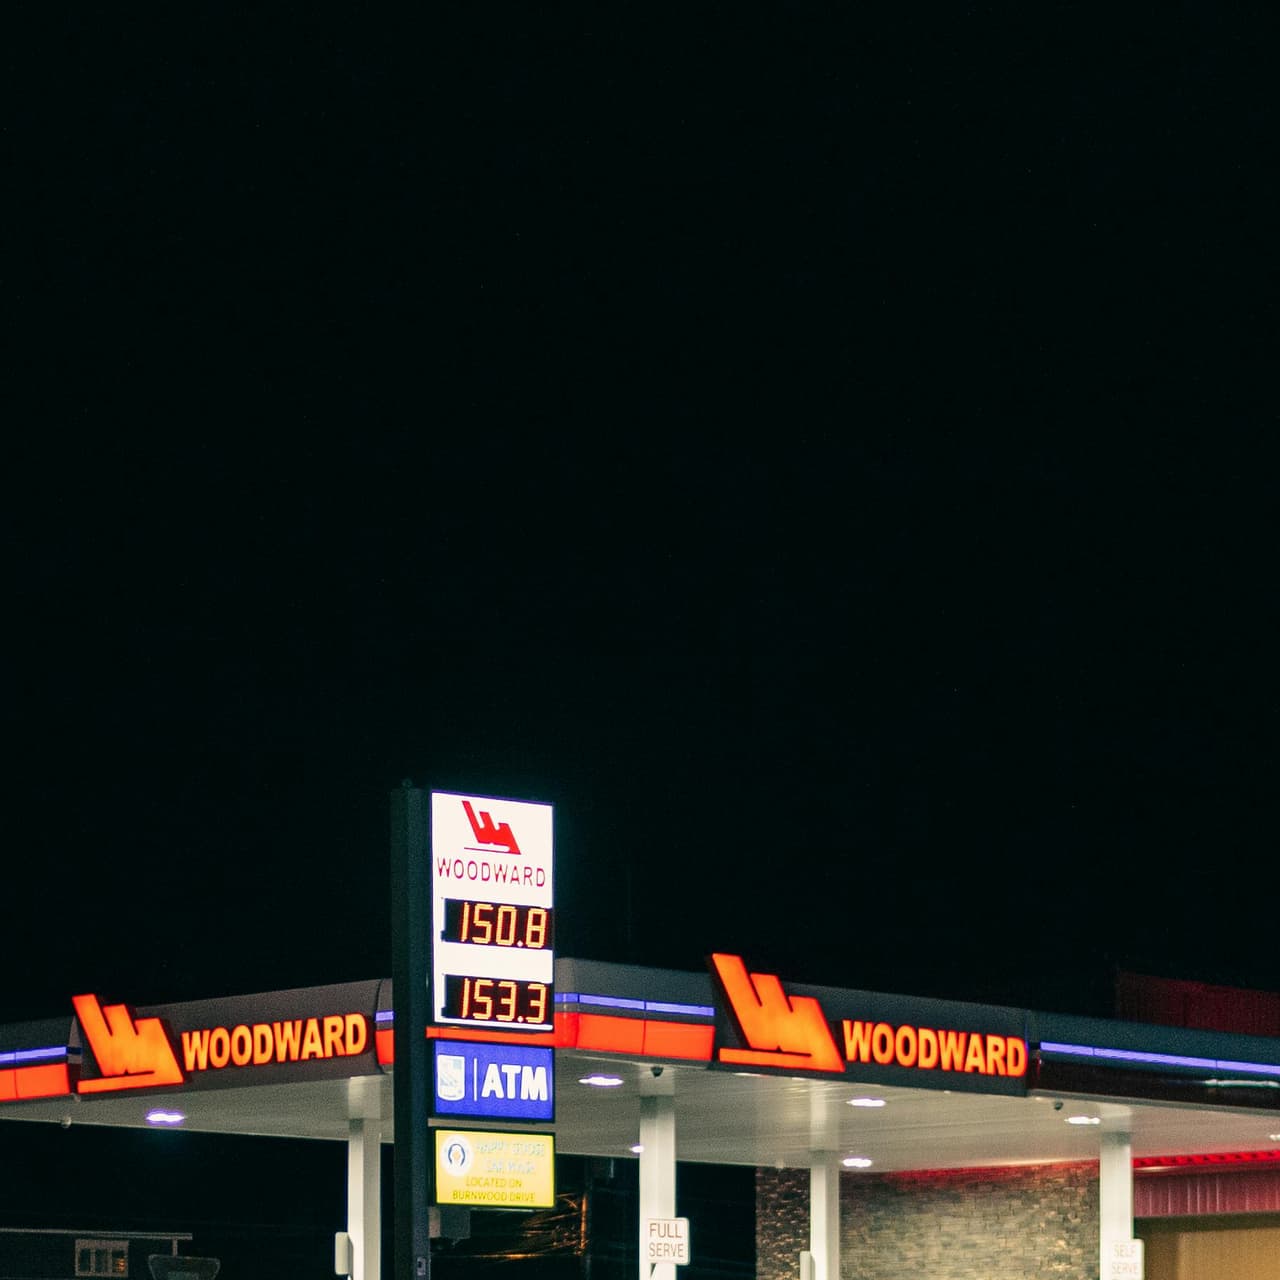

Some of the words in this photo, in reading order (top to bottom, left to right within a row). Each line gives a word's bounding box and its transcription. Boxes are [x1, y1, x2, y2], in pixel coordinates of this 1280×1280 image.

[437, 857, 546, 887] WOODWARD
[460, 902, 548, 948] 150.8
[461, 977, 548, 1024] 153.3
[181, 1012, 368, 1072] WOODWARD
[842, 1018, 1028, 1078] WOODWARD
[481, 1063, 549, 1101] ATM
[466, 1176, 506, 1188] LOCATED
[508, 1178, 522, 1188] ON
[452, 1190, 508, 1201] BURNWOOD
[509, 1191, 536, 1202] DRIVE
[649, 1222, 683, 1239] FULL
[648, 1242, 685, 1258] SERVE
[1113, 1244, 1137, 1258] SELF
[1111, 1262, 1139, 1275] SERVE
